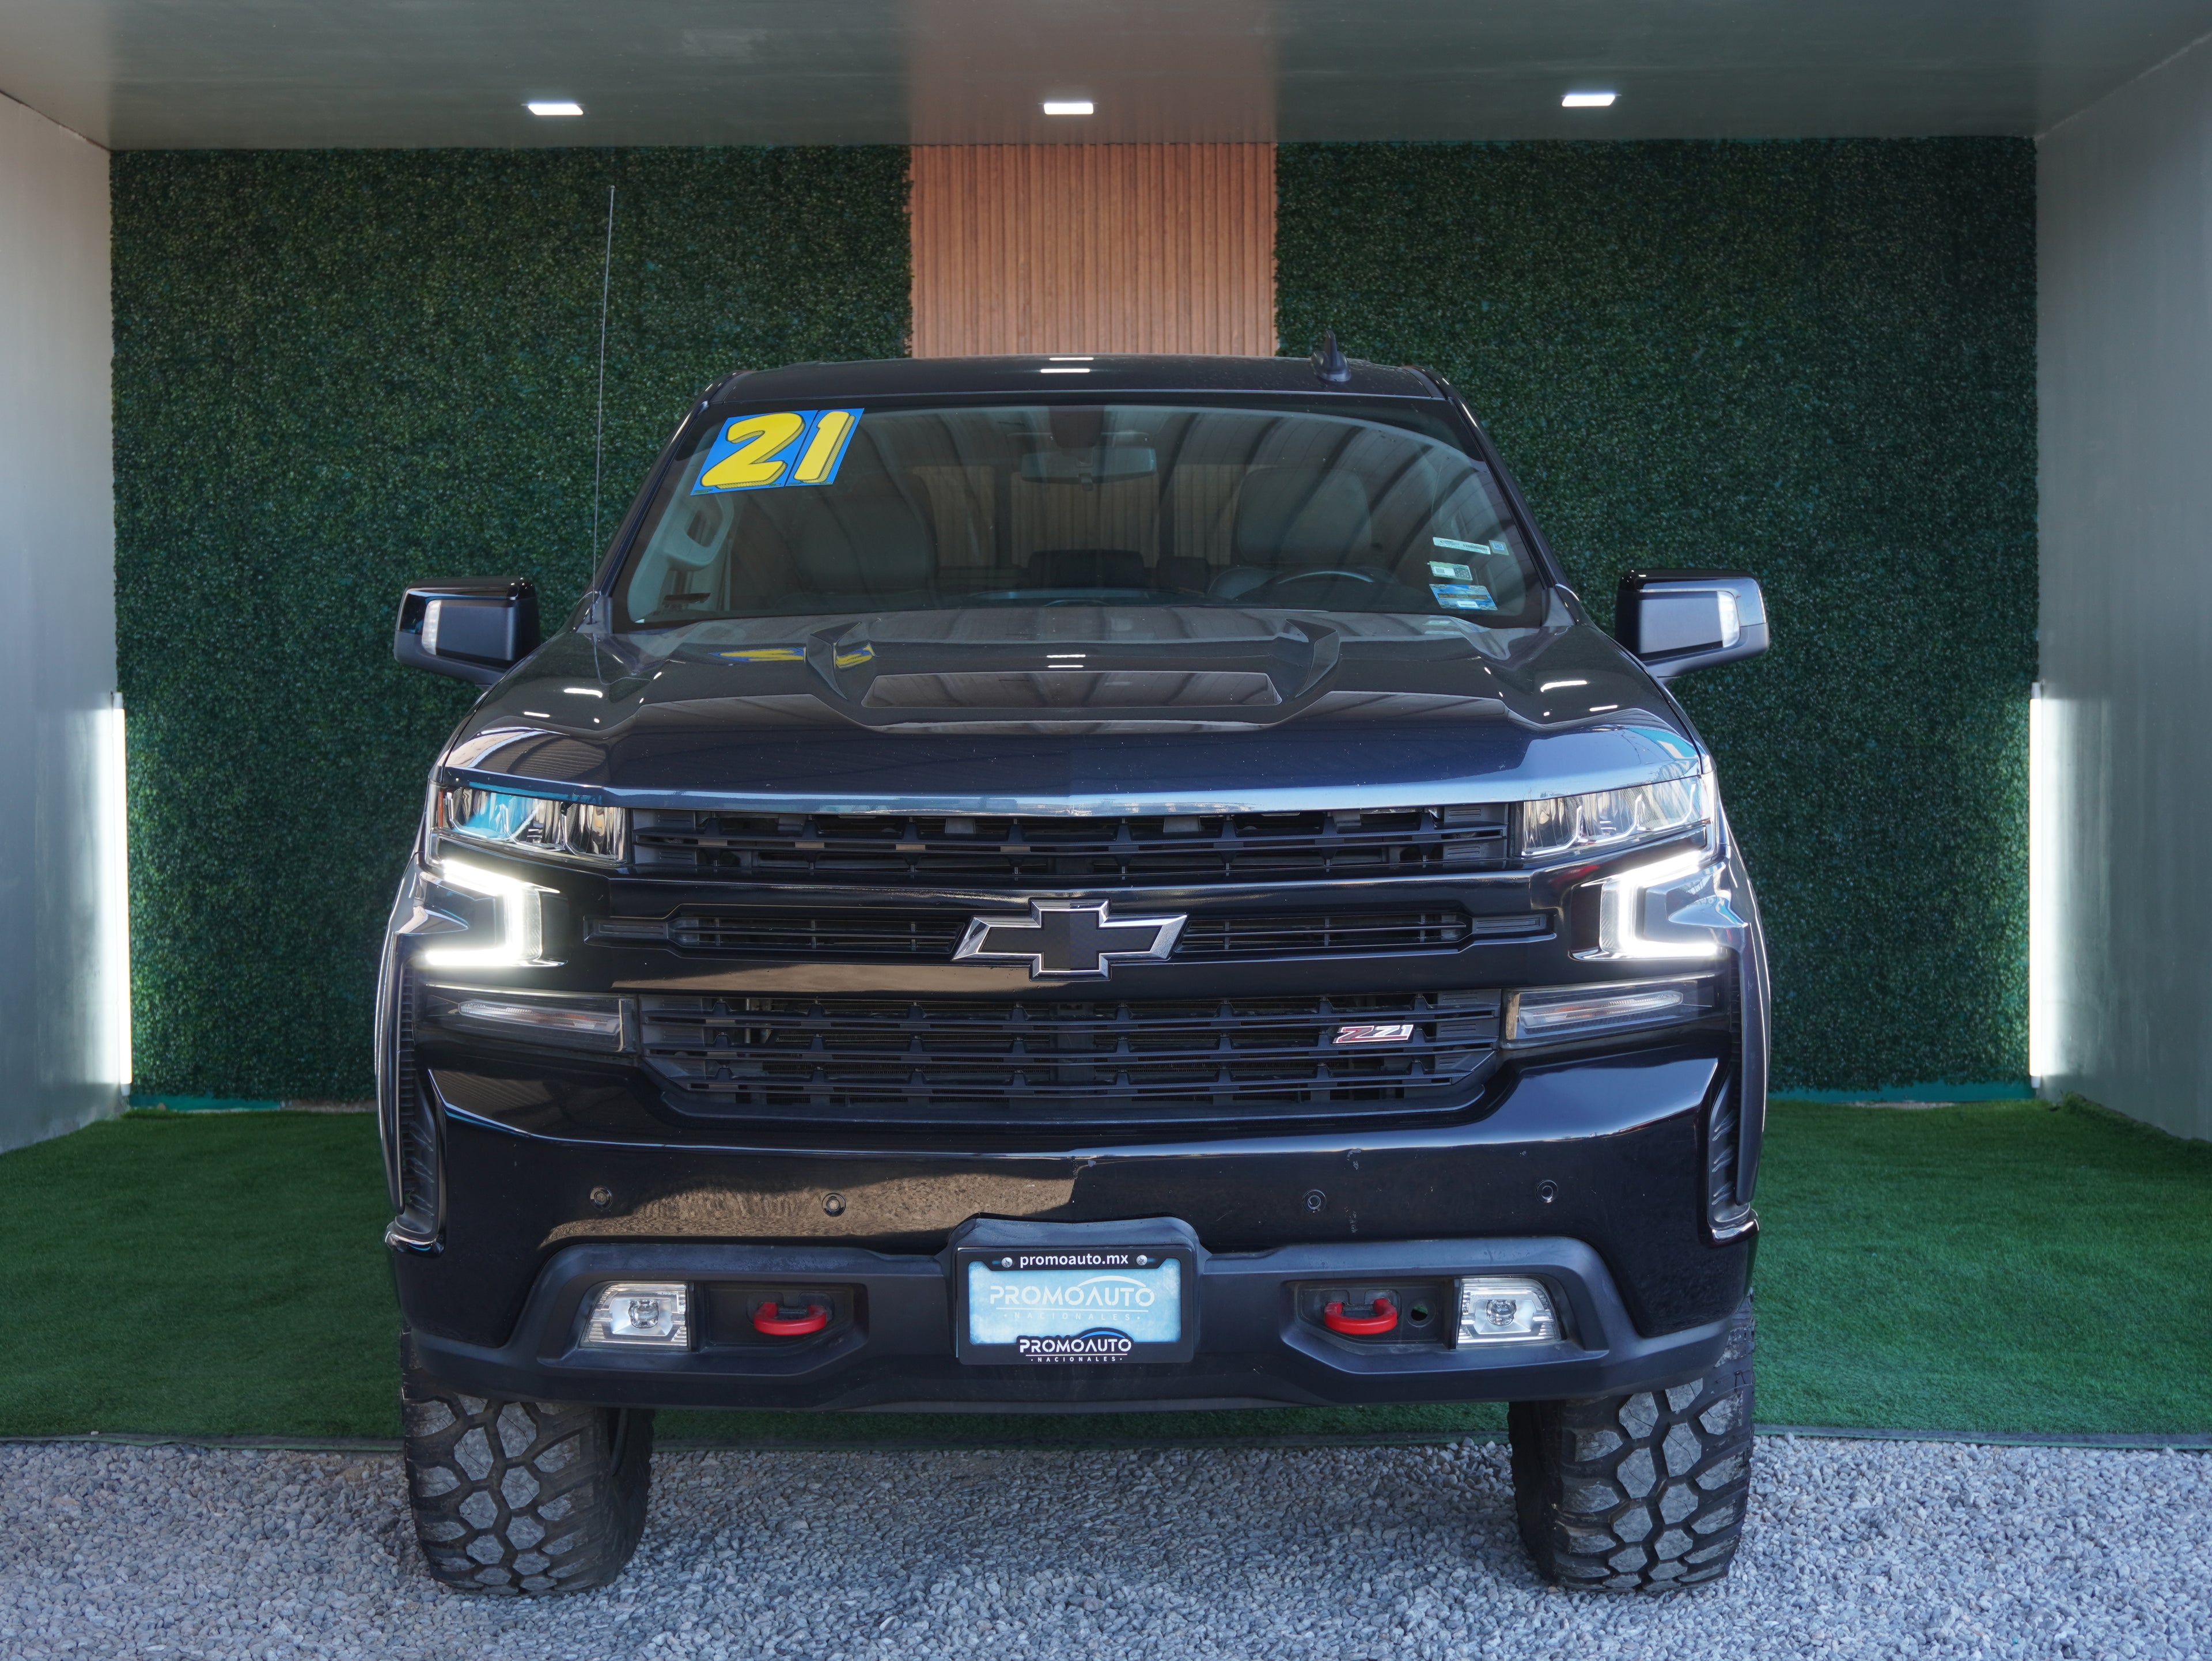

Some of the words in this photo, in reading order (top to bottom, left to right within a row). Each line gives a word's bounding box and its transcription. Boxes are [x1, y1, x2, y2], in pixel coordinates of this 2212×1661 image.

[701, 410, 856, 489] 21
[1333, 1024, 1414, 1044] Z71
[1020, 1253, 1129, 1269] promoauto.mx
[989, 1285, 1155, 1307] PROMOAUTO
[1014, 1312, 1130, 1321] NACIONALES
[1019, 1338, 1132, 1353] PROMOAUTO
